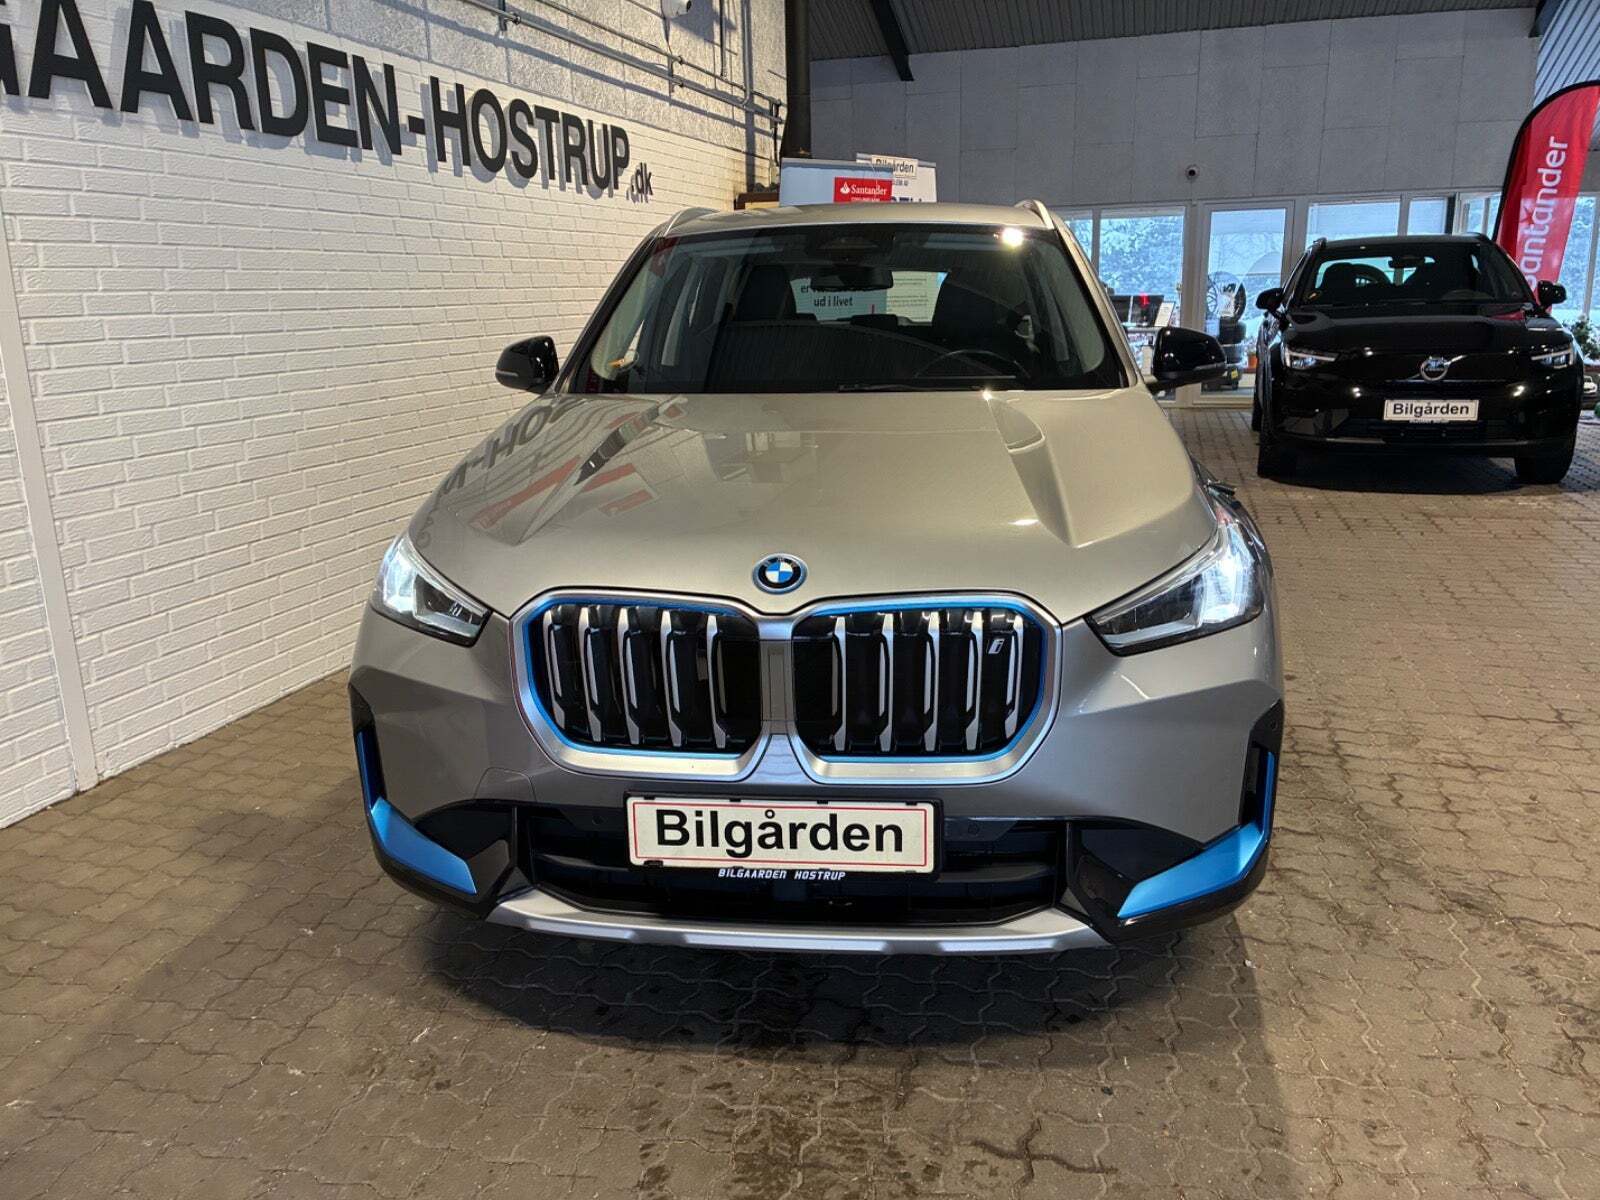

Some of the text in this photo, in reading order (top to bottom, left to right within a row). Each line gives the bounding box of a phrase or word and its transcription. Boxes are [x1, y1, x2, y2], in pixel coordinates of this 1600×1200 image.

[0, 0, 653, 195] AARDEN-HOSTRUP.dk
[851, 184, 888, 196] Santander
[814, 296, 826, 307] ud
[833, 296, 853, 307] livet
[1393, 402, 1469, 418] Bilgården
[656, 809, 903, 858] Bilgården
[718, 868, 846, 881] BILGAARDEN HOSTRUP
